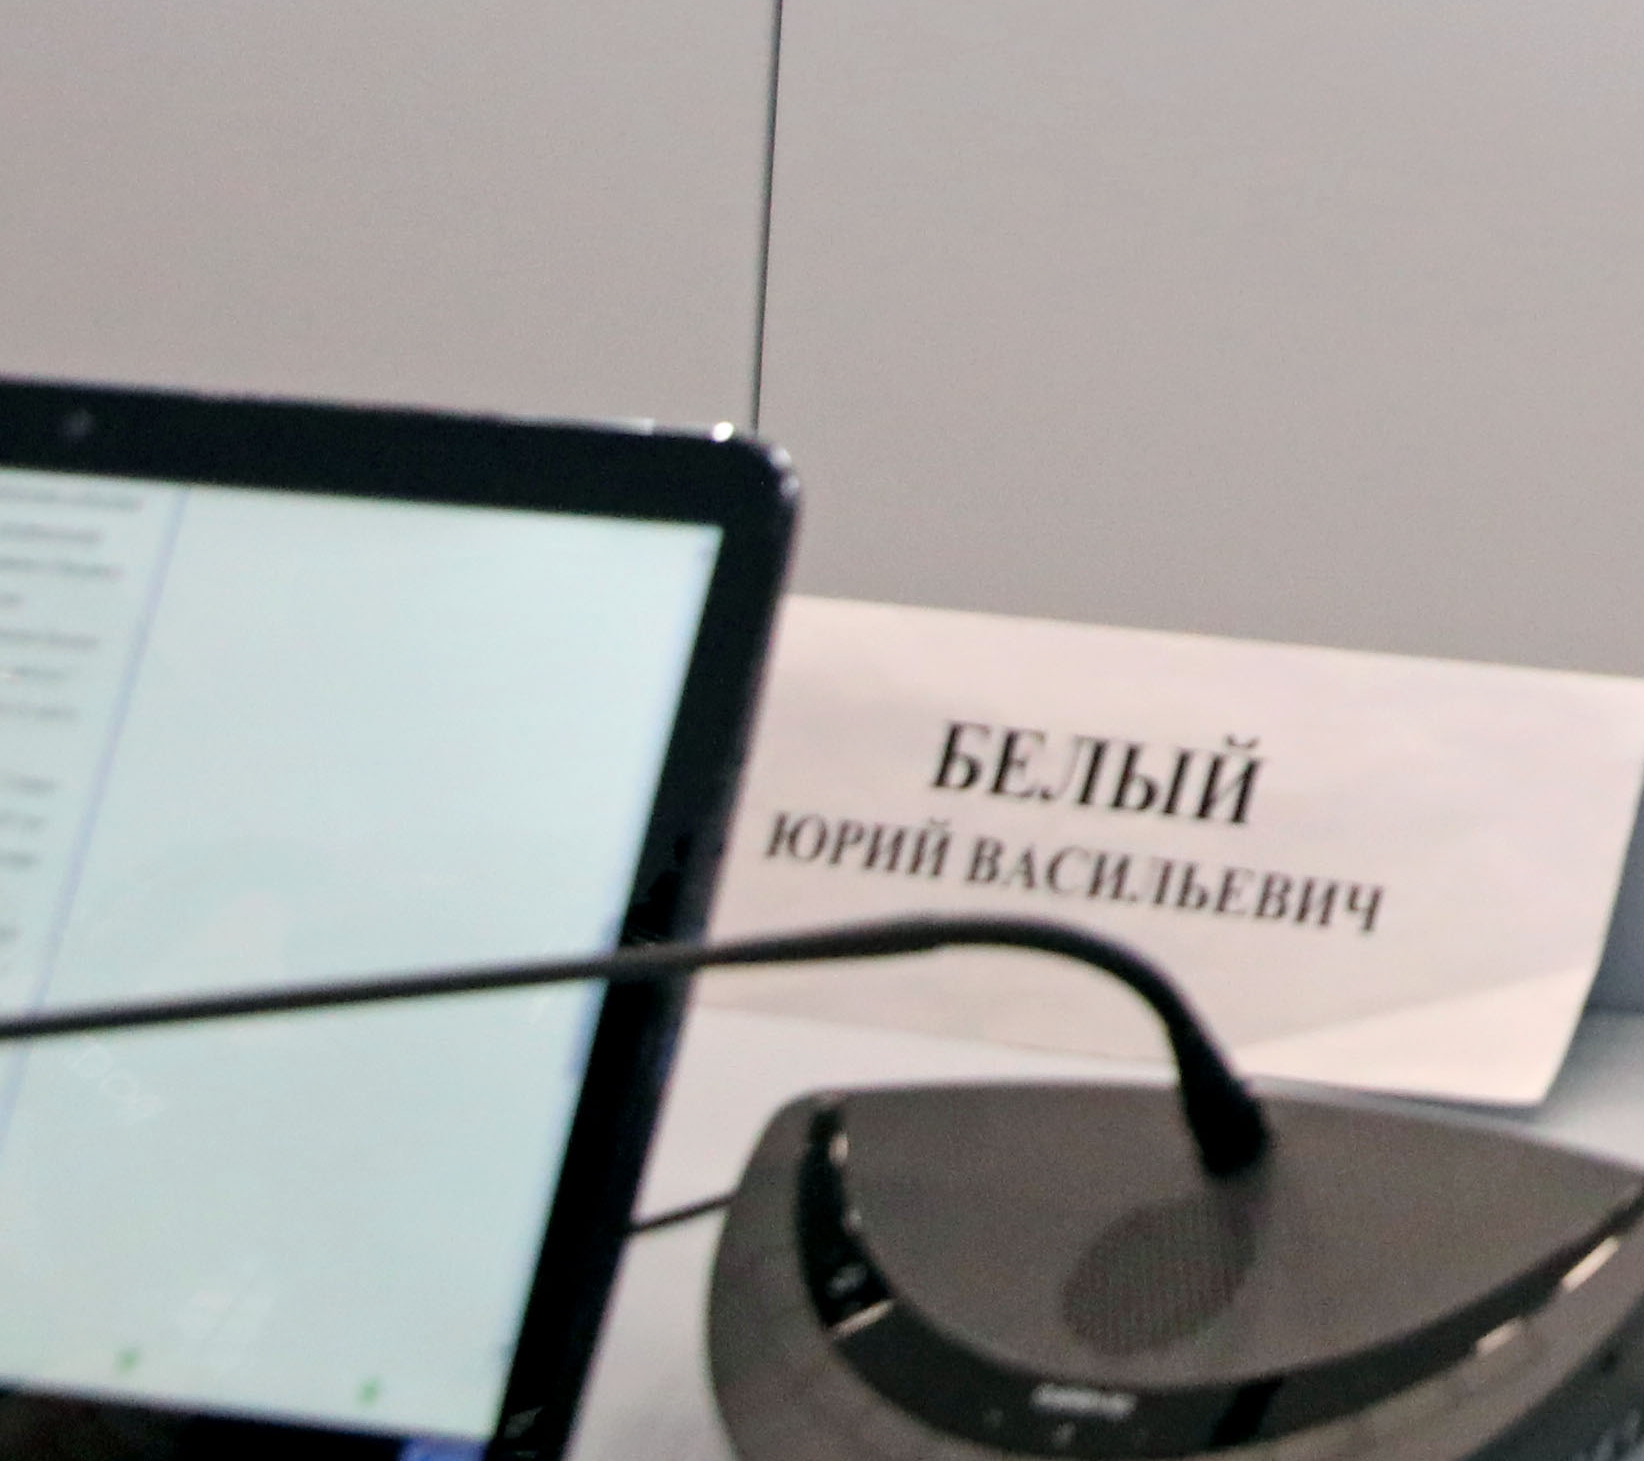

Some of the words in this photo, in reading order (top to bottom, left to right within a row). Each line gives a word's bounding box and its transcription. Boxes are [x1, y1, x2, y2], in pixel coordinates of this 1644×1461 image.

[930, 719, 1267, 826] БЕЛЫЙ
[764, 811, 954, 878] ЮРИЙ
[963, 835, 1385, 933] ВАСИЛЬЕВИЧ
